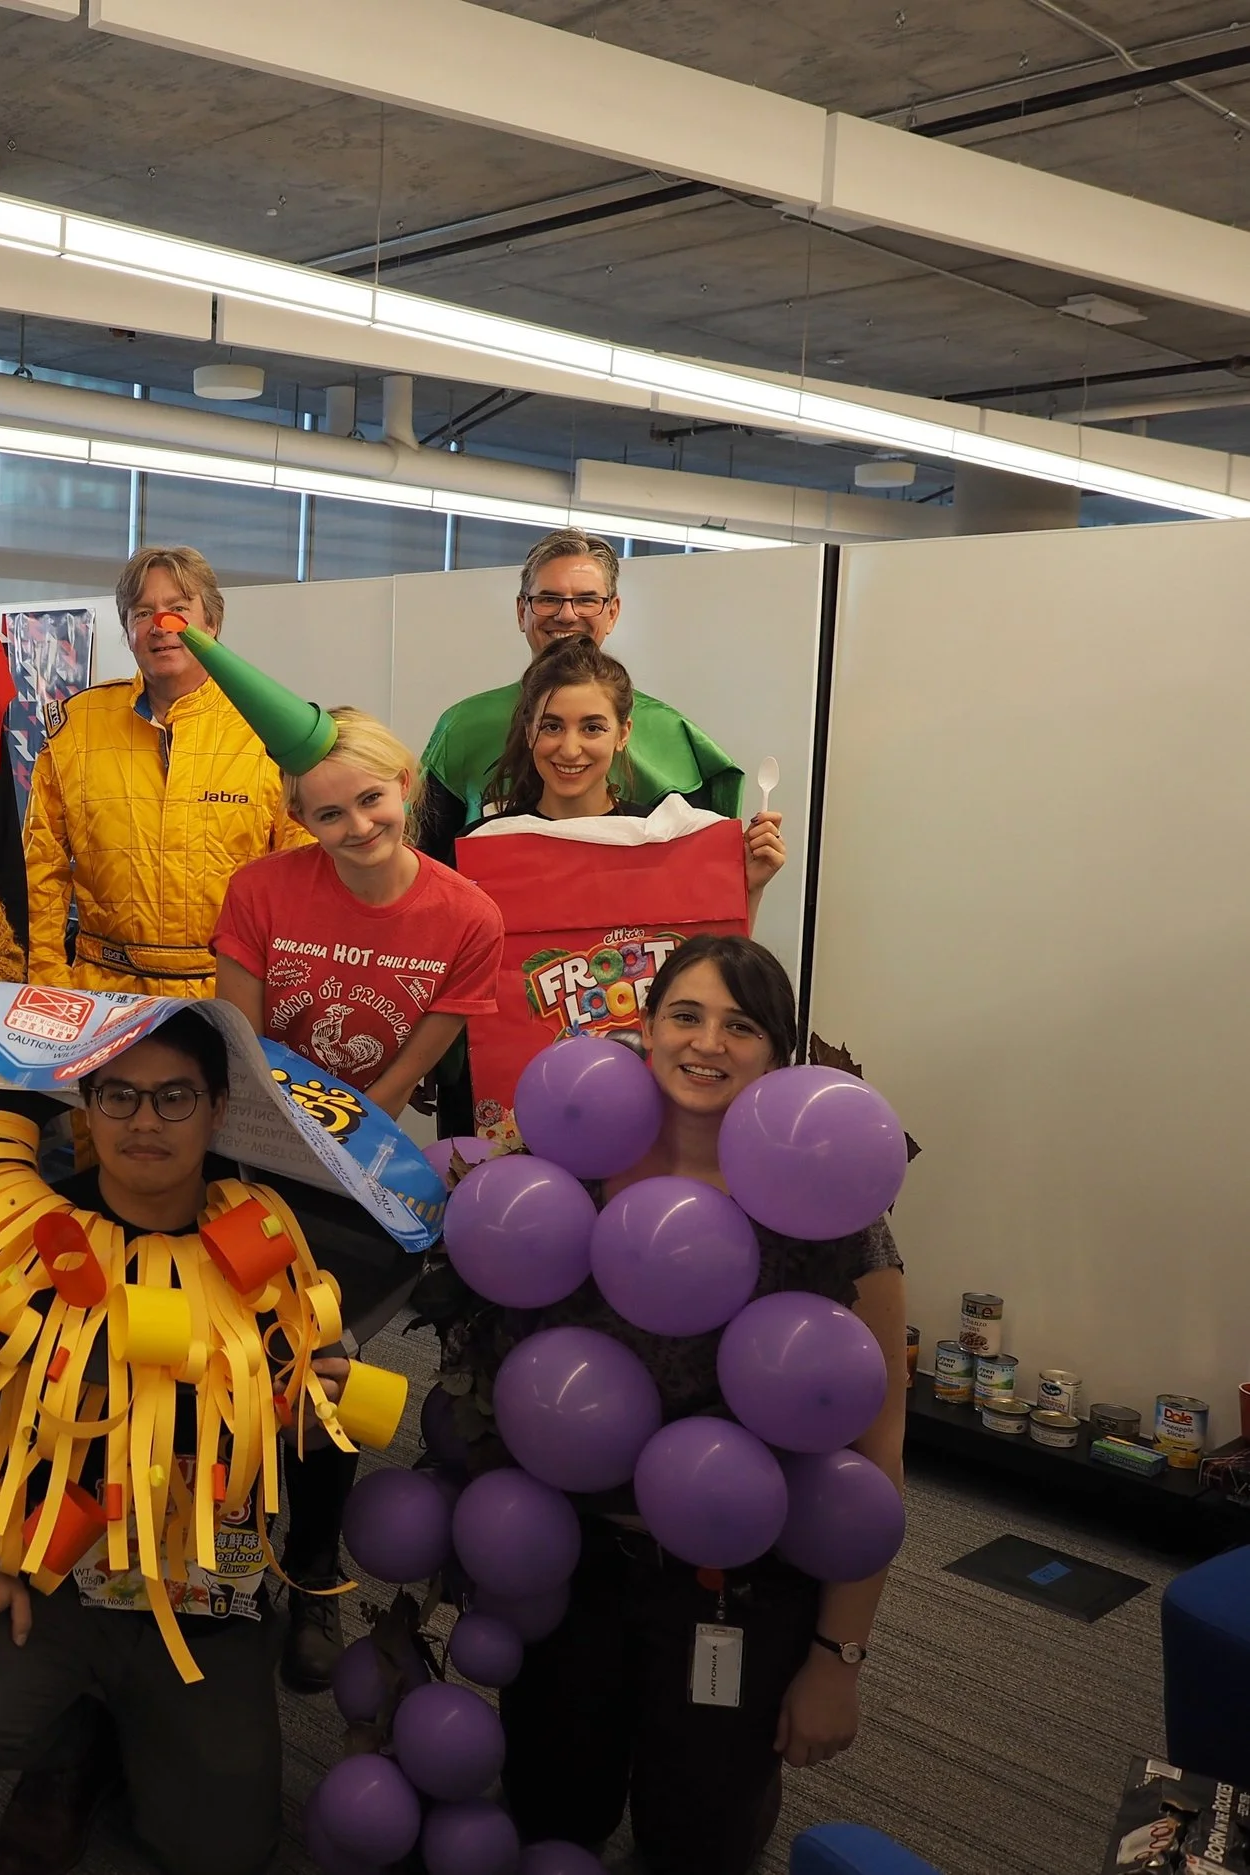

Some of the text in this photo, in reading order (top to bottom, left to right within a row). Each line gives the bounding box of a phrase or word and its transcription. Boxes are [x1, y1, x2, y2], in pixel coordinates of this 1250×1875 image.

[197, 791, 249, 804] Jabra
[604, 928, 645, 946] elika's
[272, 937, 448, 974] SRIRACHA HOT CHILI SAUCE
[274, 968, 297, 977] NATURAL
[285, 971, 304, 980] COLOR
[538, 940, 675, 1007] FROOT
[407, 984, 423, 1002] WELL
[412, 978, 429, 1000] SHAKE
[565, 978, 655, 1026] LOOP
[13, 1010, 76, 1033] DO NOT MICROWAVE
[349, 984, 412, 1048] SRIRACH
[7, 1032, 58, 1050] CAUTION:
[53, 1050, 75, 1059] WILL
[59, 1026, 141, 1077] NISSIN
[1164, 1407, 1193, 1424] Dole
[1161, 1420, 1194, 1434] Pineapple
[1167, 1429, 1186, 1438] Slices
[216, 1551, 263, 1563] eafood
[219, 1564, 249, 1574] Flavor
[107, 1598, 135, 1606] Noodle
[710, 1654, 718, 1697] ANTONIA
[1203, 1827, 1226, 1863] BORN
